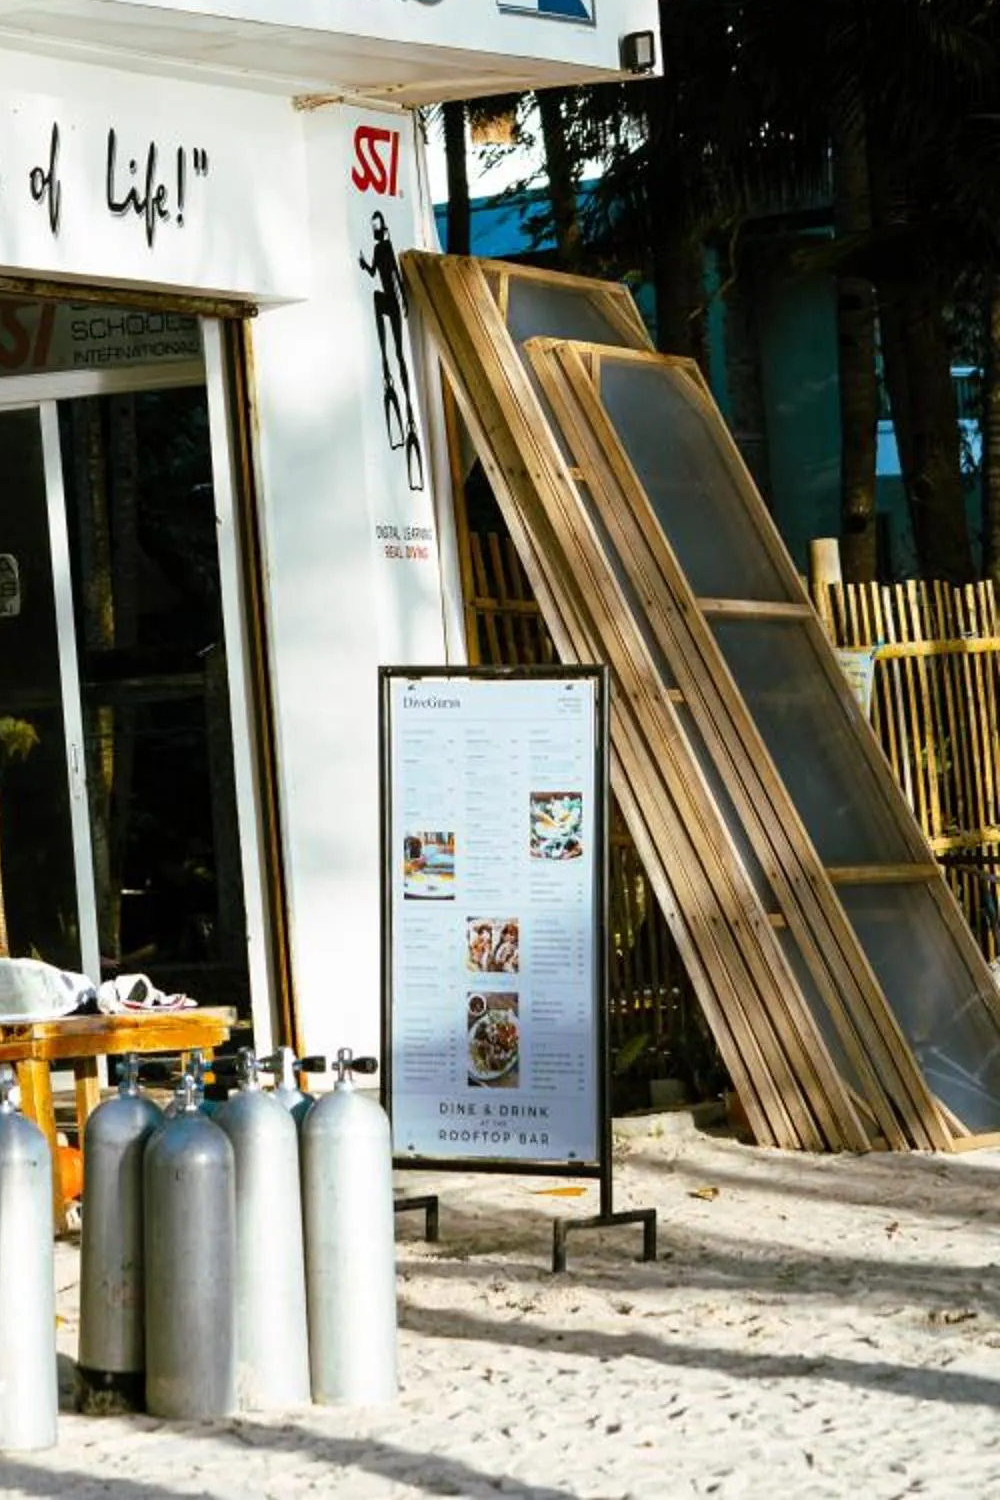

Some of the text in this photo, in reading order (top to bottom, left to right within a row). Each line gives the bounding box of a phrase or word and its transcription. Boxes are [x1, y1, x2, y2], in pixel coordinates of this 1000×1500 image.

[351, 125, 400, 197] SSI
[29, 121, 61, 236] of
[106, 127, 208, 248] Life!"
[440, 1102, 477, 1116] DINE
[499, 1105, 550, 1119] DRINK
[438, 1128, 550, 1148] ROOFTOP BAR
